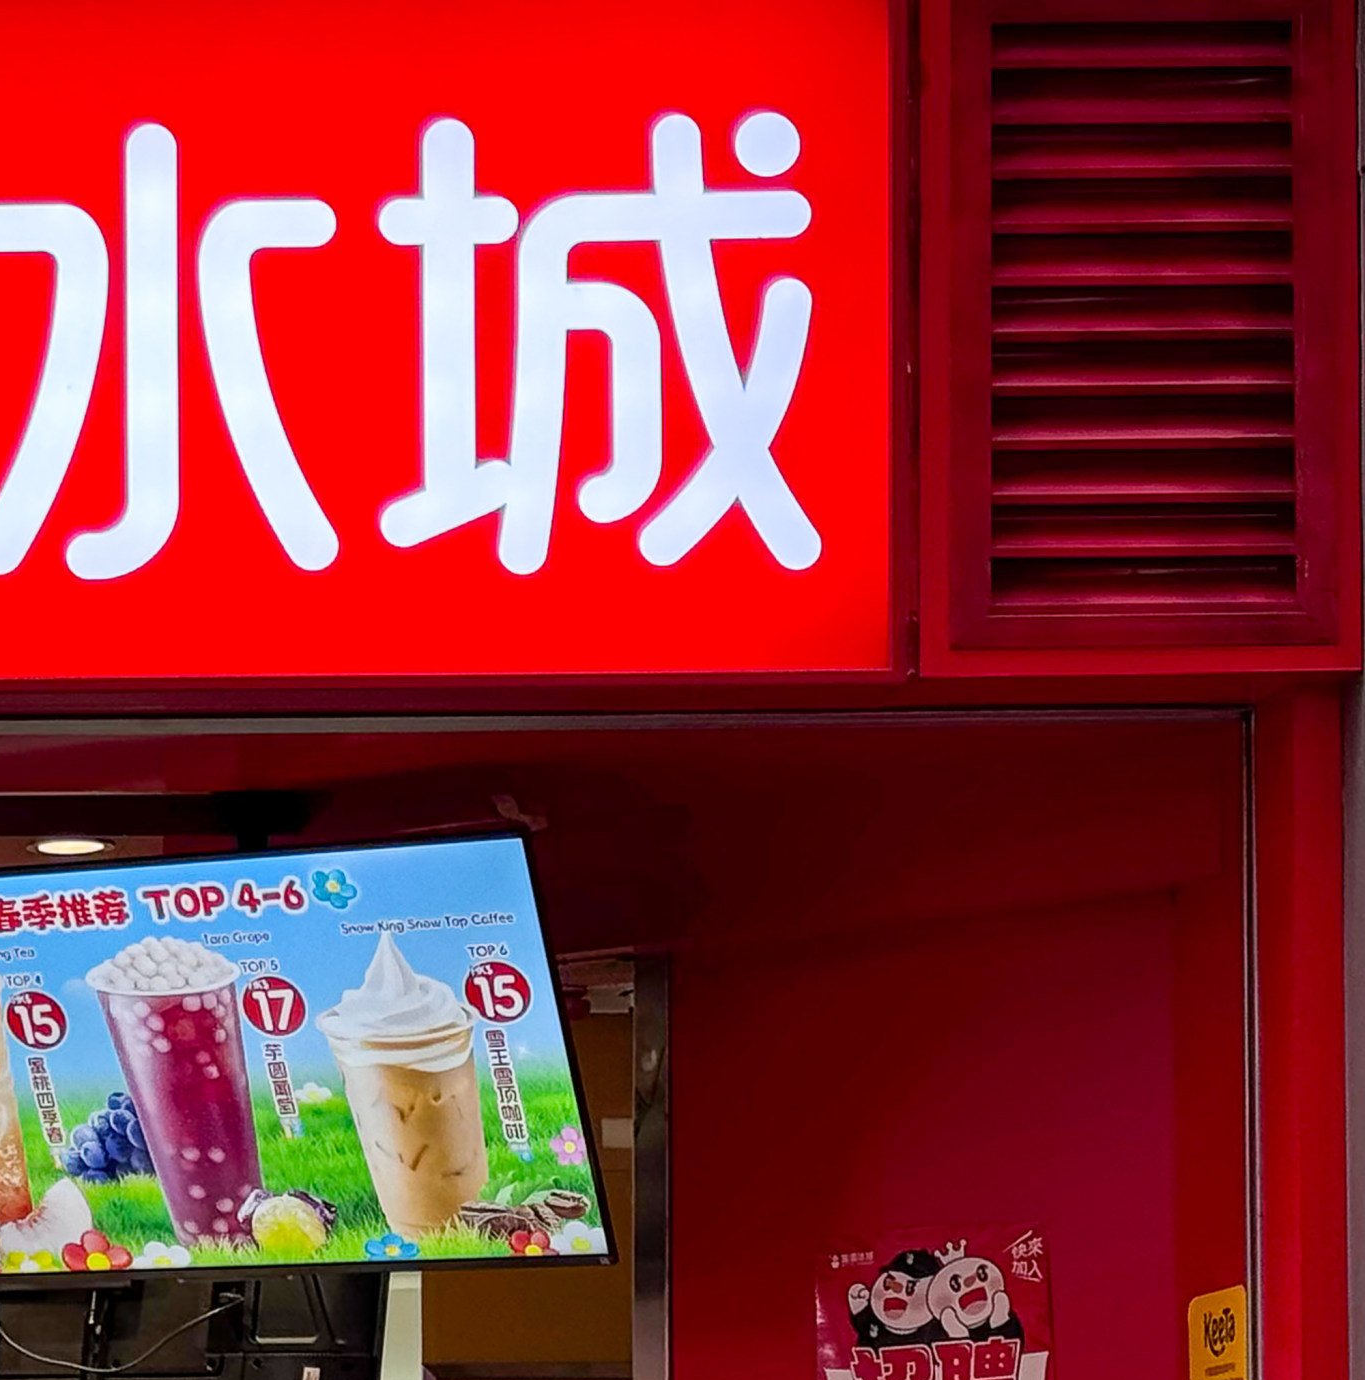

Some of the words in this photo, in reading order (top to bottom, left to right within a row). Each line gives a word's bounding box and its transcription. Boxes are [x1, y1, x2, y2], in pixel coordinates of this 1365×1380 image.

[142, 887, 225, 920] TOP
[237, 880, 305, 913] 4-6
[468, 945, 495, 958] TOP
[6, 975, 31, 987] TOP
[473, 975, 525, 1019] 15
[14, 1002, 60, 1045] 15
[252, 988, 294, 1033] 17
[485, 1029, 526, 1140] 雪王雪顶咖啡
[1011, 1260, 1043, 1280] 加入
